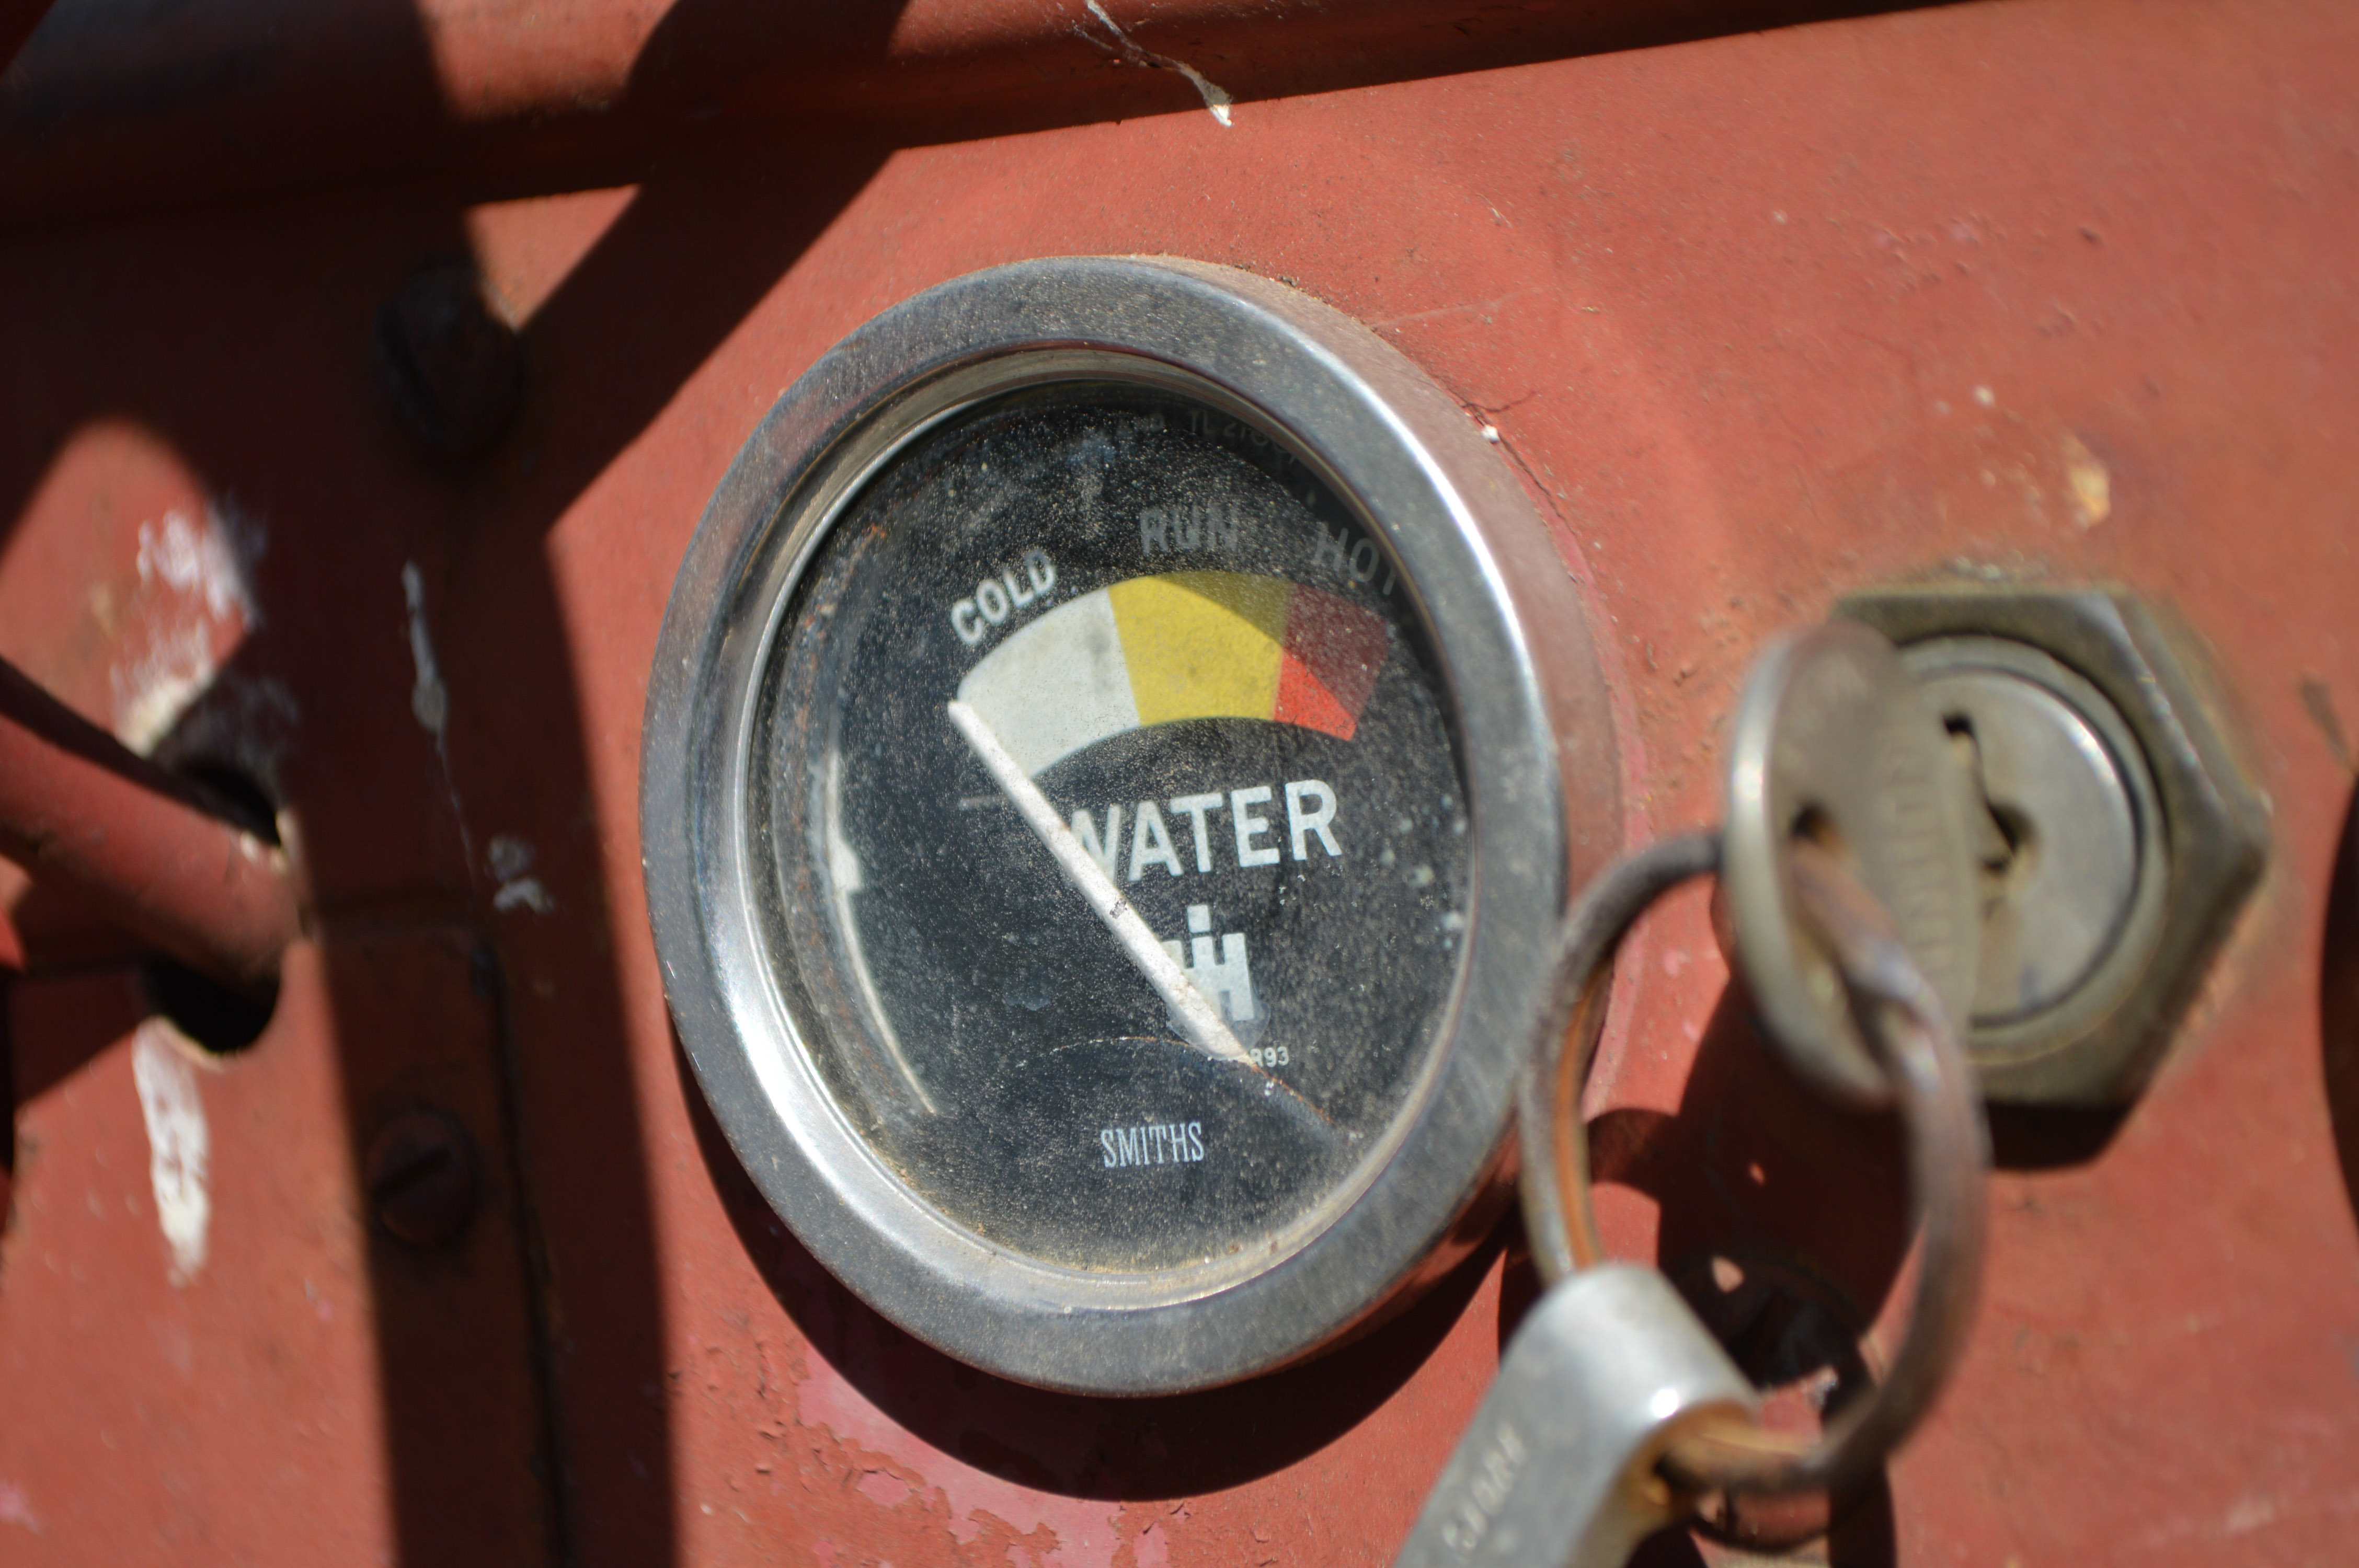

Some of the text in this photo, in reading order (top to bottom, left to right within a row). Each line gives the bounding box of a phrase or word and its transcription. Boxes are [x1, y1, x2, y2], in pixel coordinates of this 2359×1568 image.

[1139, 502, 1239, 554] RUN
[950, 548, 1057, 645] COLD
[1101, 1121, 1204, 1168] SMITHS
